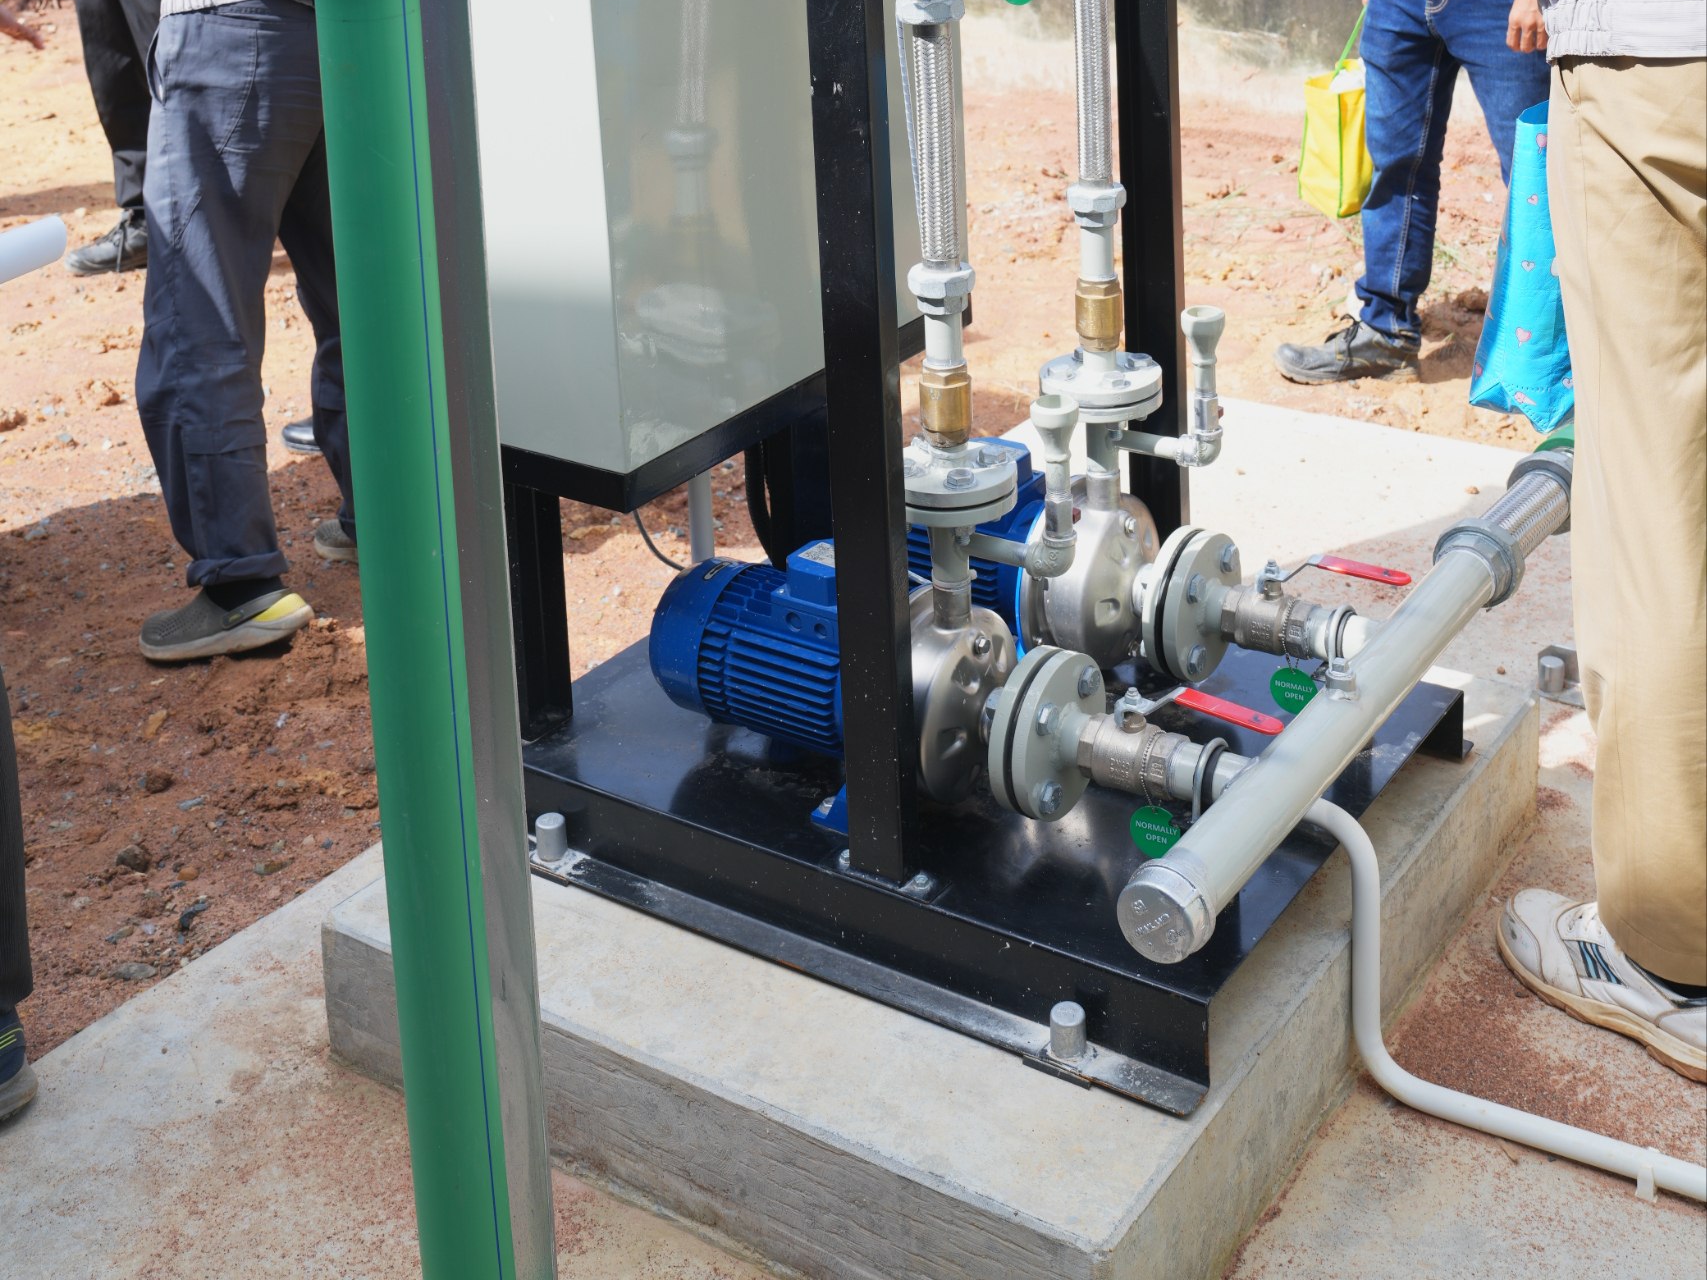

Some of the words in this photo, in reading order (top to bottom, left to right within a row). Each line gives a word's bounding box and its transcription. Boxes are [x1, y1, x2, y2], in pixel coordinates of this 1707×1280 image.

[1275, 679, 1313, 693] NORMALLY
[1284, 691, 1304, 701] OPEN
[1135, 820, 1178, 836] NORMALLY
[1145, 833, 1168, 844] OPEN
